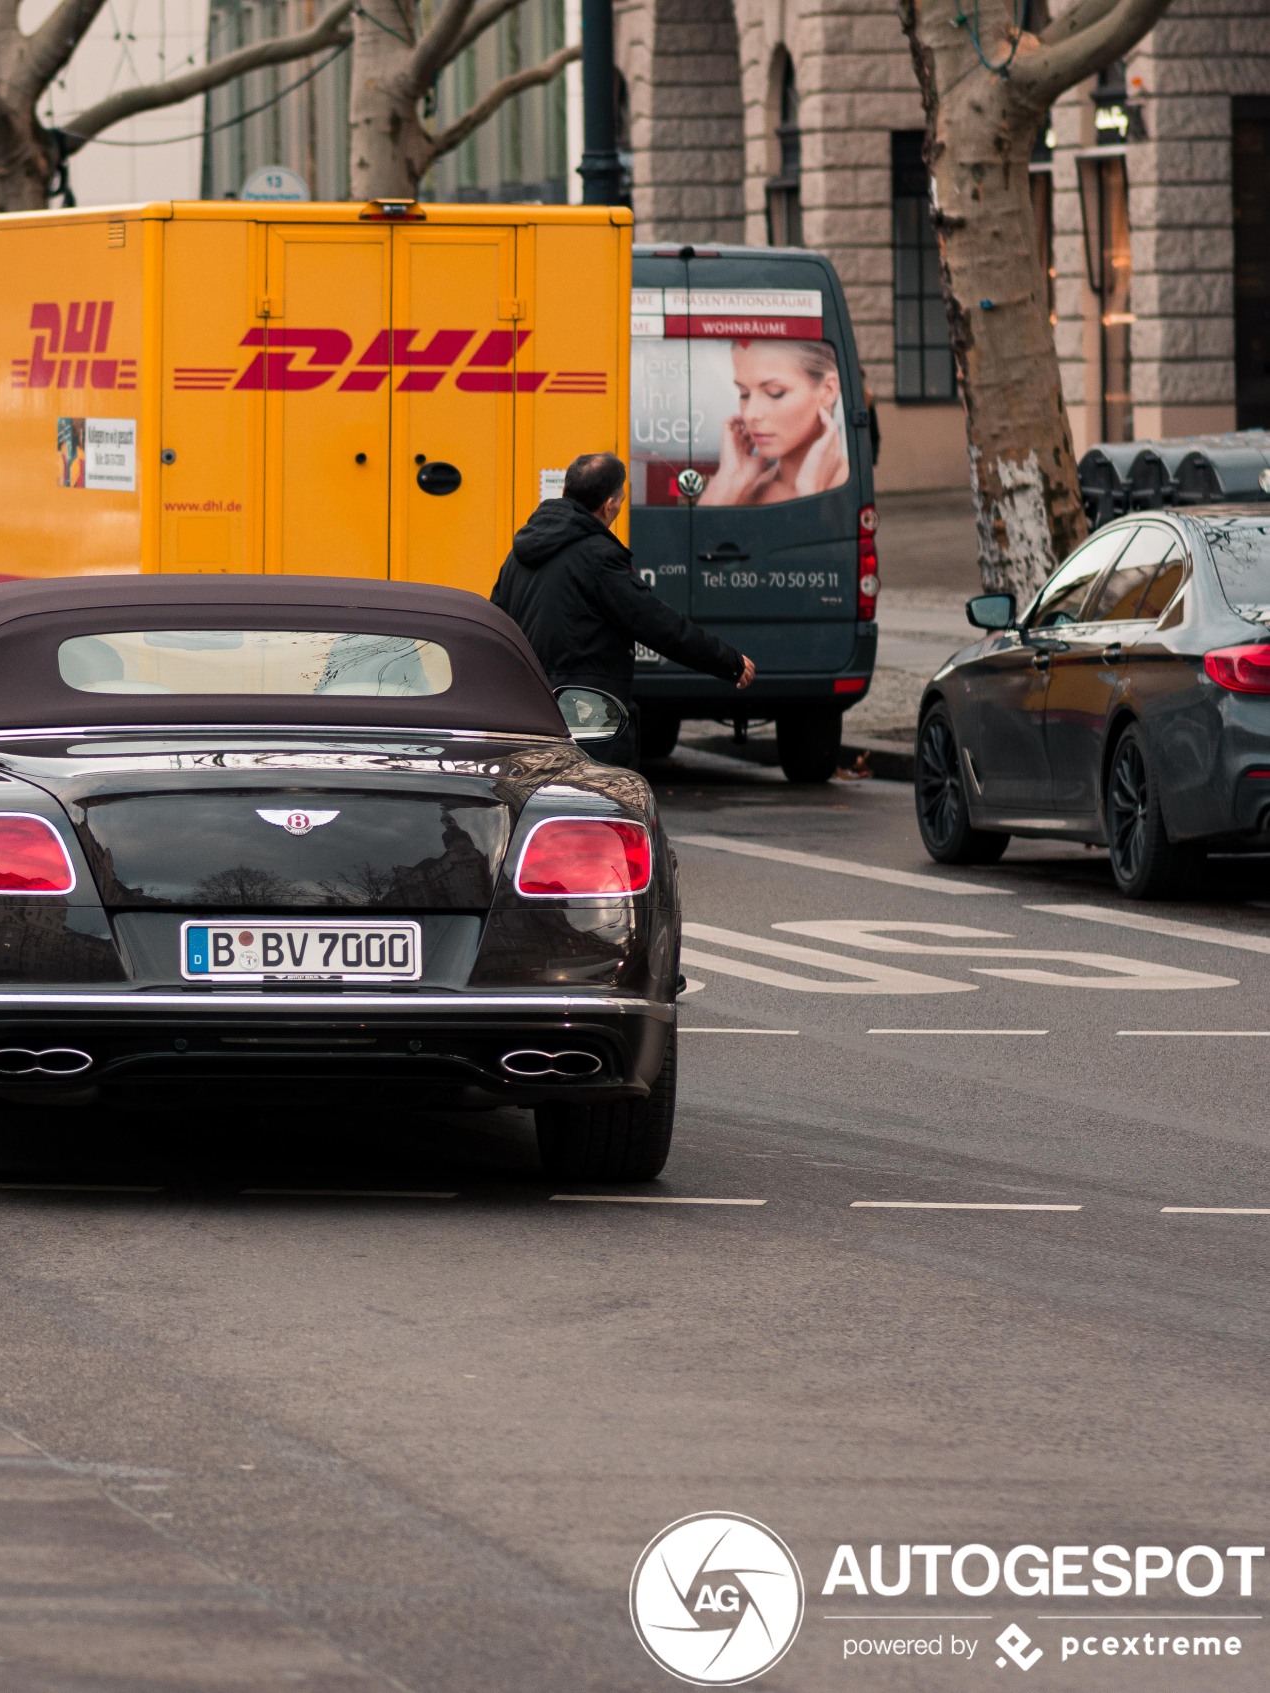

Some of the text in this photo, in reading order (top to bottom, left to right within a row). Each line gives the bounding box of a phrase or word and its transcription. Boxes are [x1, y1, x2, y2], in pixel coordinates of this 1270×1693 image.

[266, 175, 283, 189] 13
[673, 293, 813, 308] PRÄSENTATIONSRÄUME
[701, 320, 788, 335] WOHNRÄUME
[28, 301, 118, 389] DHL
[232, 327, 550, 394] DHL
[164, 501, 243, 512] www.dhl.de
[702, 571, 727, 588] Tel:
[731, 571, 757, 588] 030
[769, 572, 785, 588] 70
[788, 572, 805, 588] 50
[808, 572, 825, 588] 95
[828, 572, 839, 588] 11
[194, 933, 409, 967] D B BV 7000
[680, 919, 1241, 995] US
